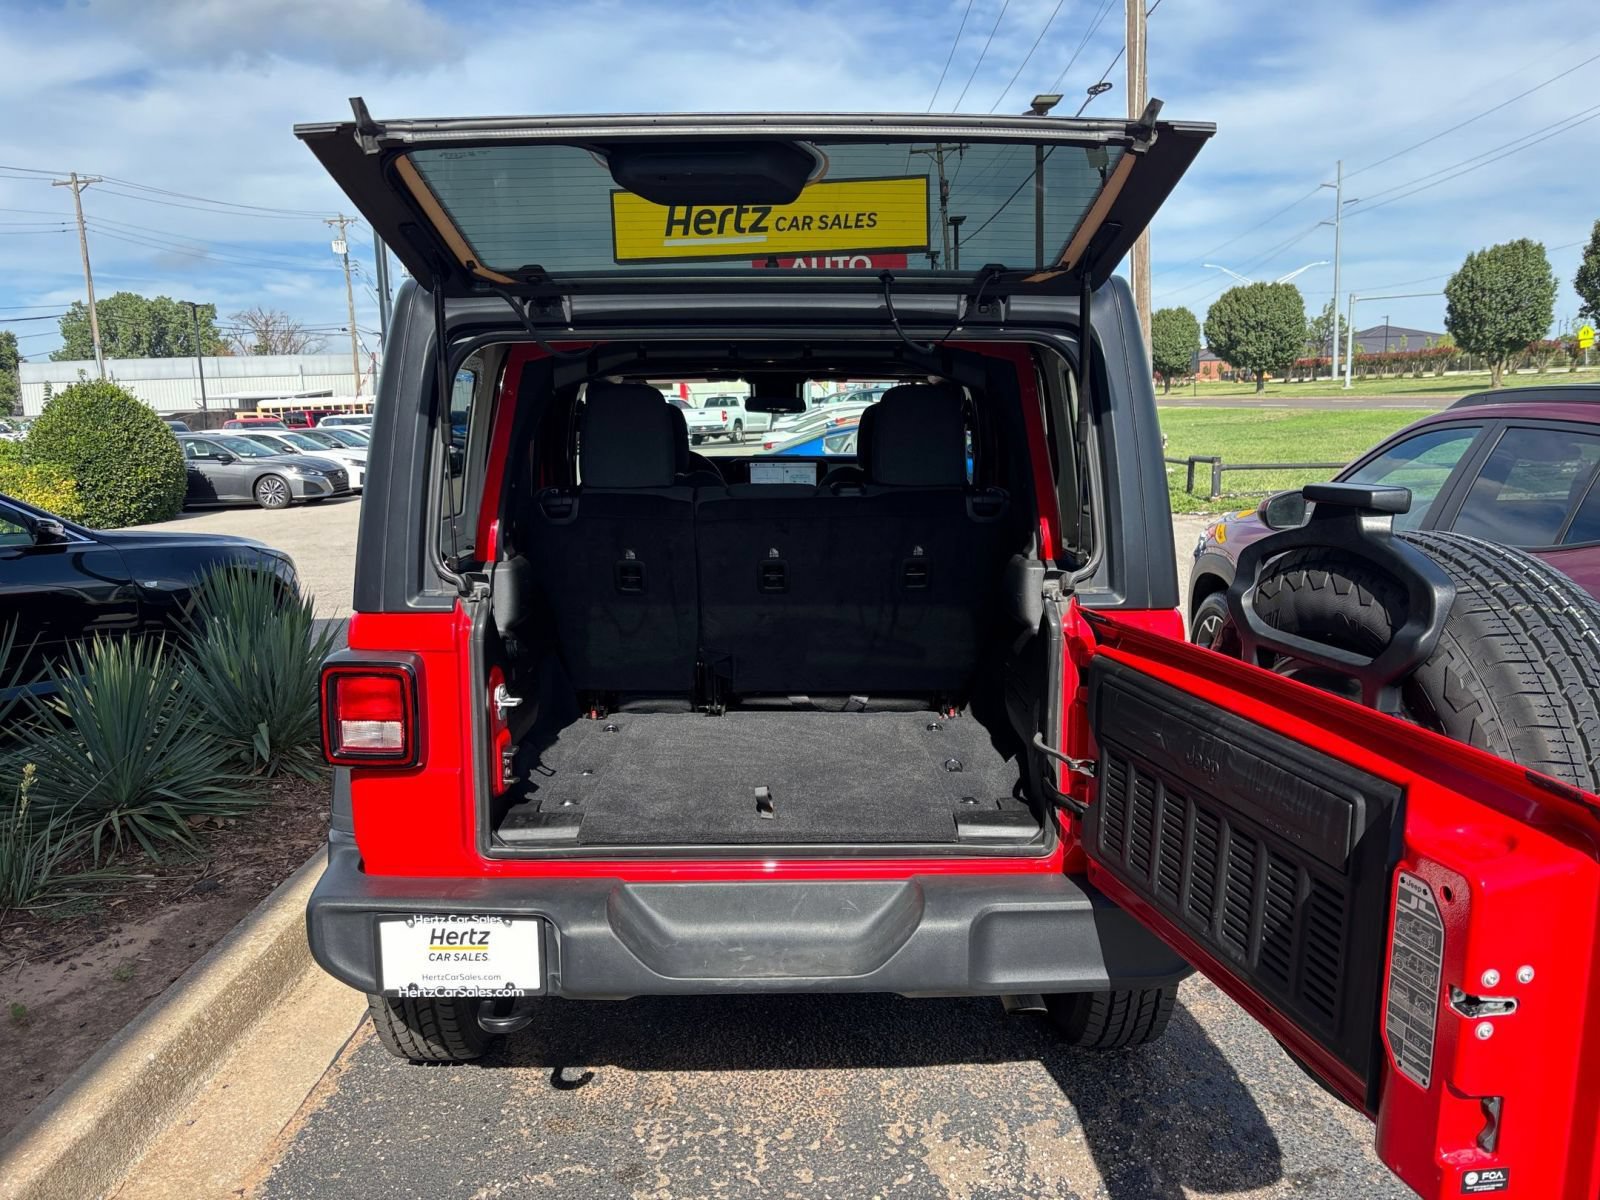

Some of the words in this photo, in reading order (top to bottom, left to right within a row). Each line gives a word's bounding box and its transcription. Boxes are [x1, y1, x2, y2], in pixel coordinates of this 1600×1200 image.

[665, 205, 772, 237] Hertz
[775, 216, 814, 232] CAR
[817, 212, 878, 231] SALES
[791, 255, 872, 268] AUTO
[1186, 744, 1220, 784] Jeep
[1406, 880, 1422, 893] Jeep
[1399, 895, 1437, 918] JL
[413, 915, 446, 924] Hertz
[448, 915, 469, 924] Car
[471, 915, 502, 924] Sales
[430, 928, 490, 945] Hertz
[428, 952, 451, 962] CAR
[453, 952, 488, 962] SALES
[421, 973, 502, 982] HertzCarSales.com
[398, 987, 525, 998] HertzCarSales.com
[1406, 1032, 1428, 1053] USA
